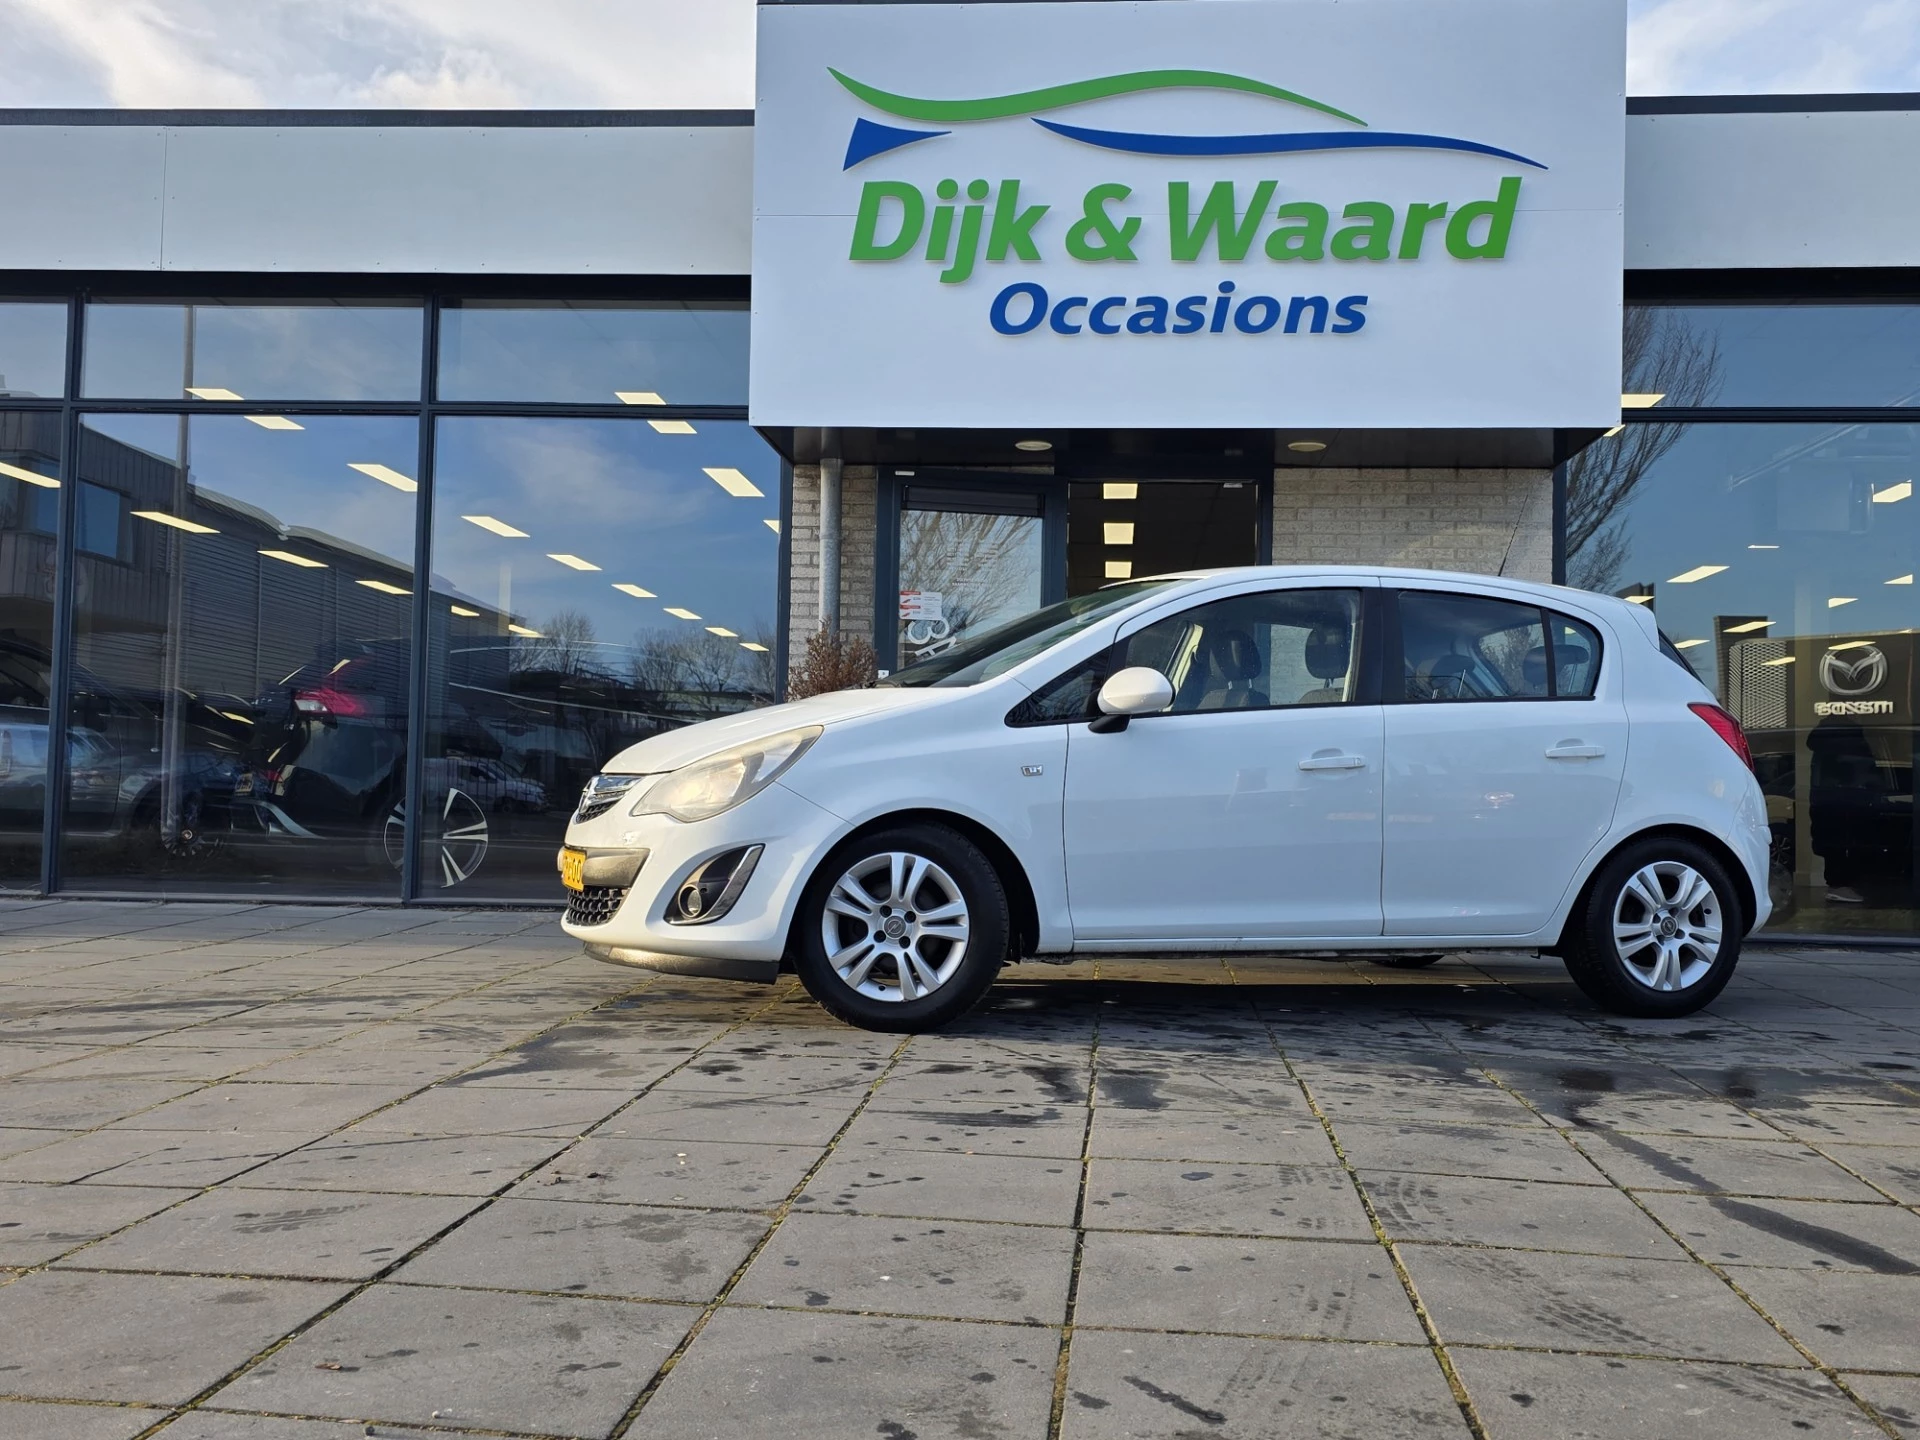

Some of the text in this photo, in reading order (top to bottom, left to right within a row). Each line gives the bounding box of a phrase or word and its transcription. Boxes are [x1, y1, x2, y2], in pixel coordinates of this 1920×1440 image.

[849, 176, 1522, 284] Dijk & Waard
[989, 281, 1368, 336] Occasions
